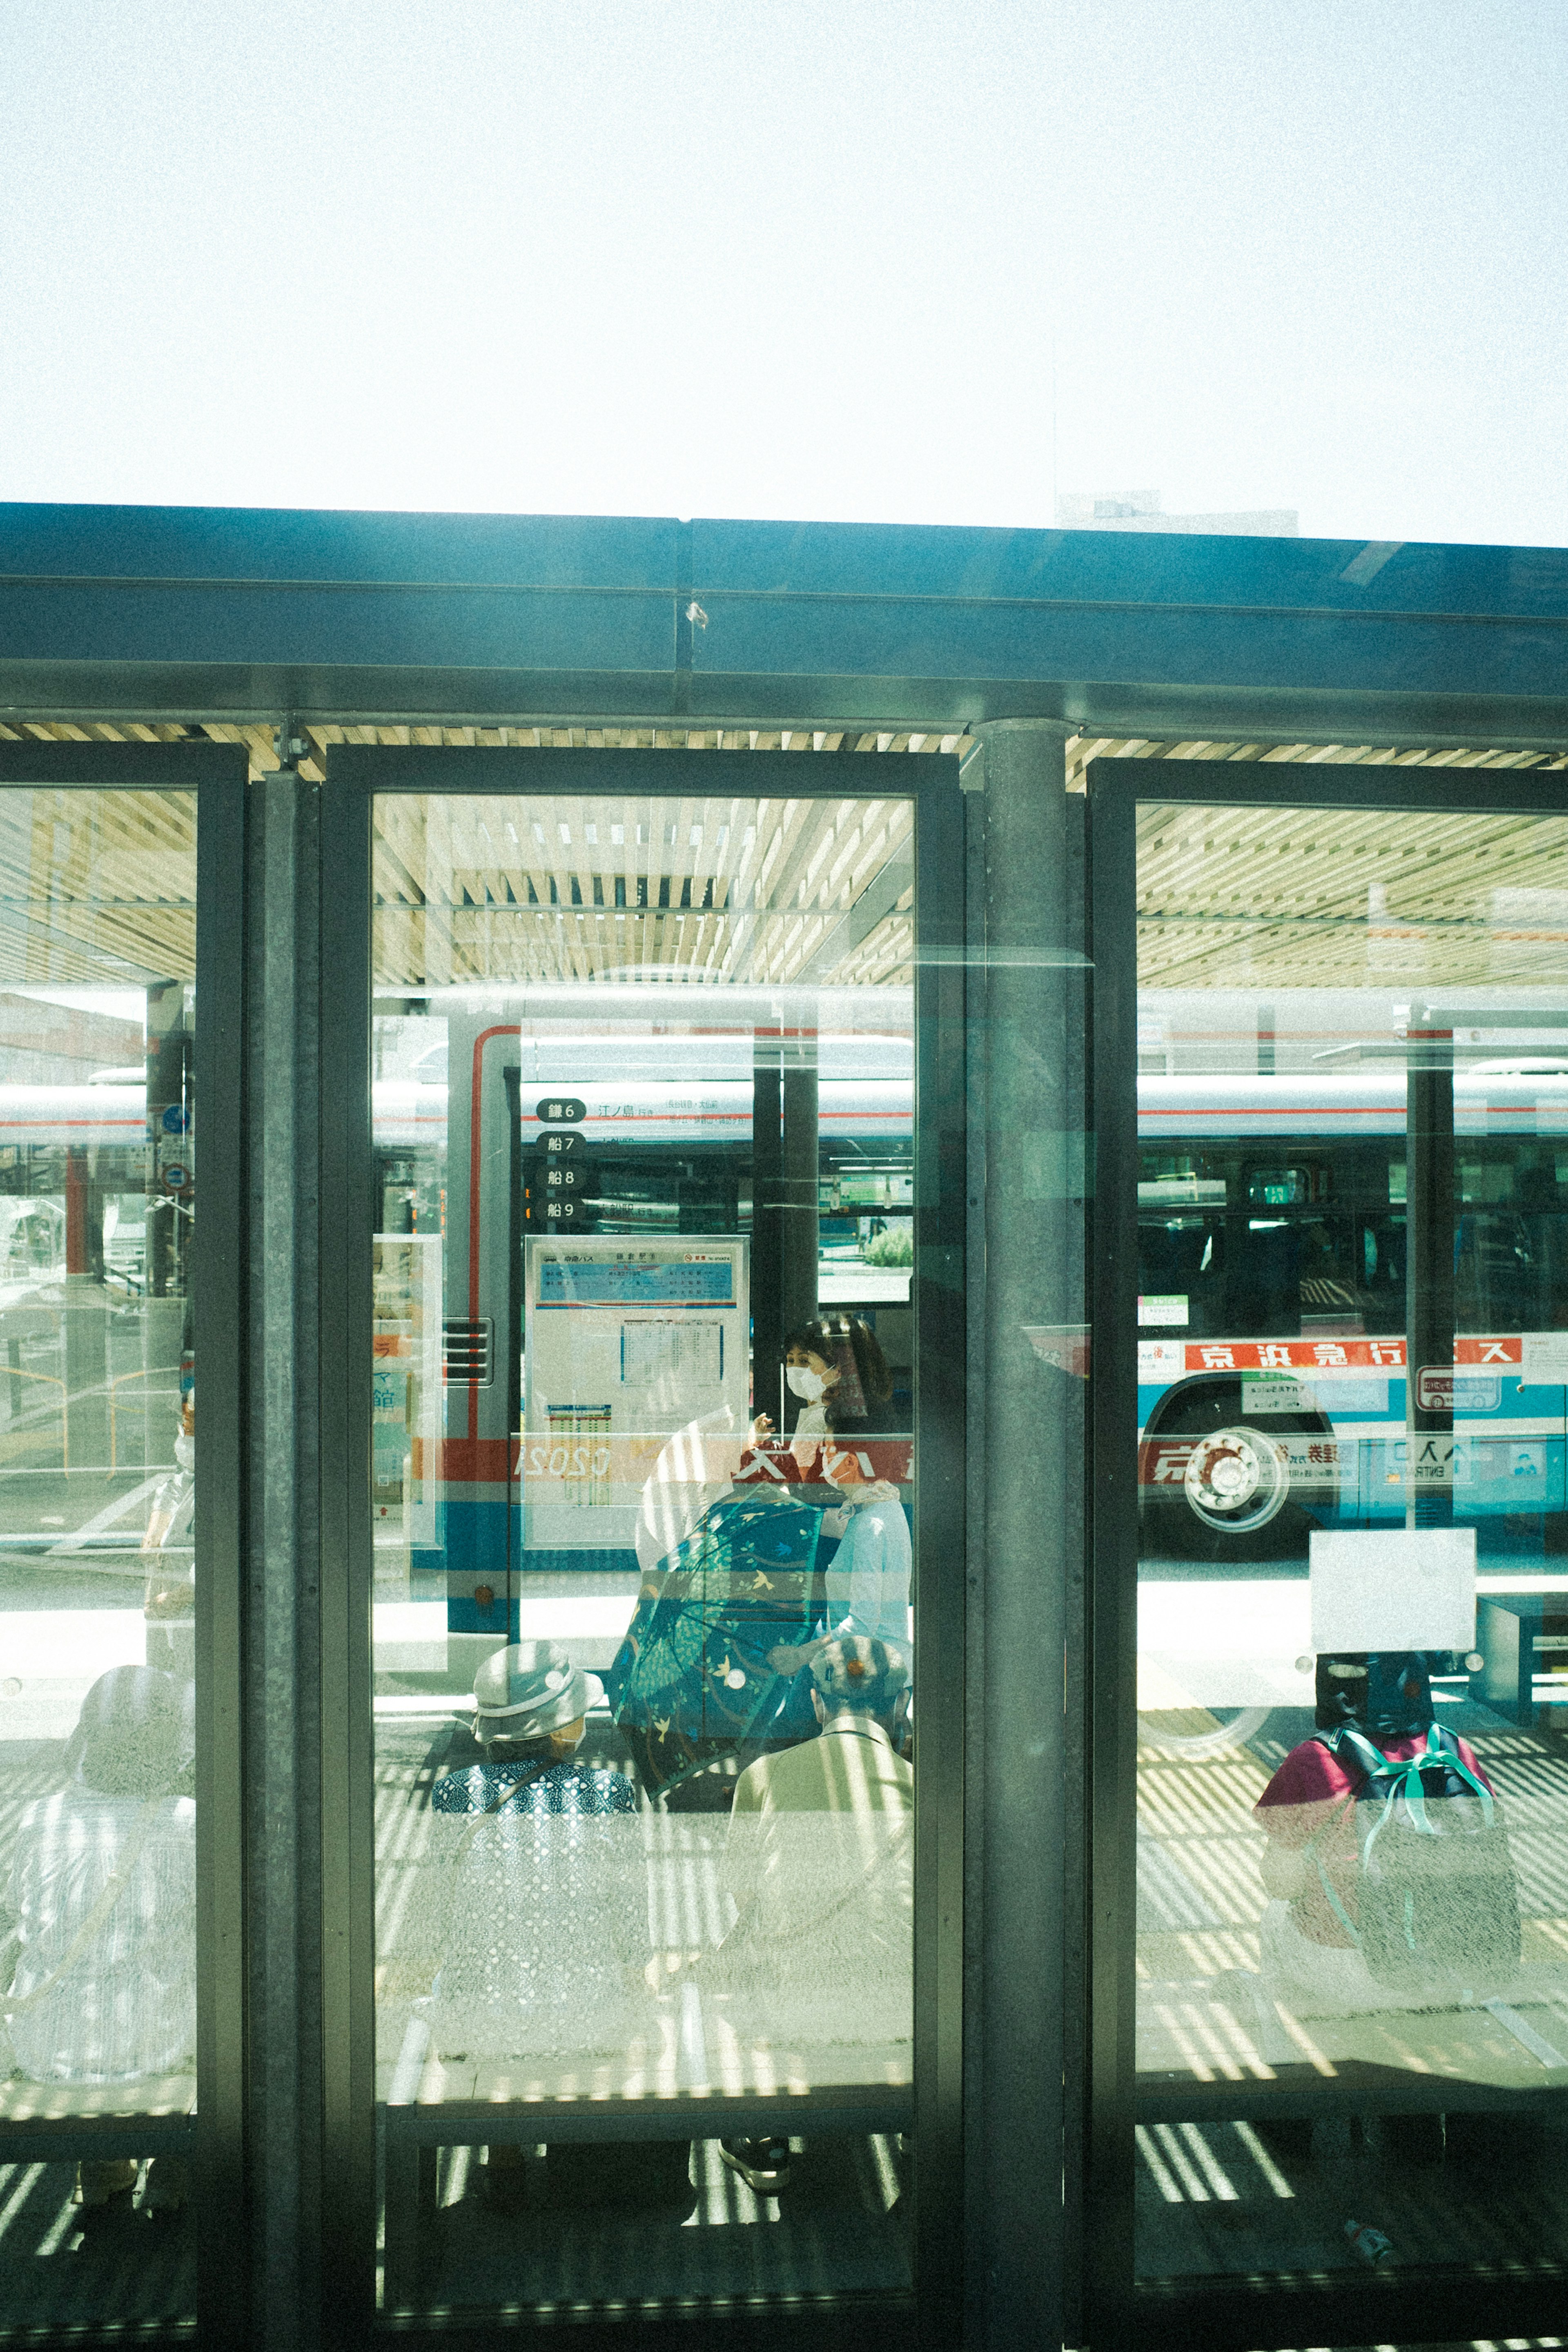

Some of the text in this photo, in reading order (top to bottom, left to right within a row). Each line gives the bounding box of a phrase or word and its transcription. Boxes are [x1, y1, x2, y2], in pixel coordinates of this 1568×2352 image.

[598, 1105, 634, 1118] 江ノ島
[638, 1109, 654, 1118] 行き
